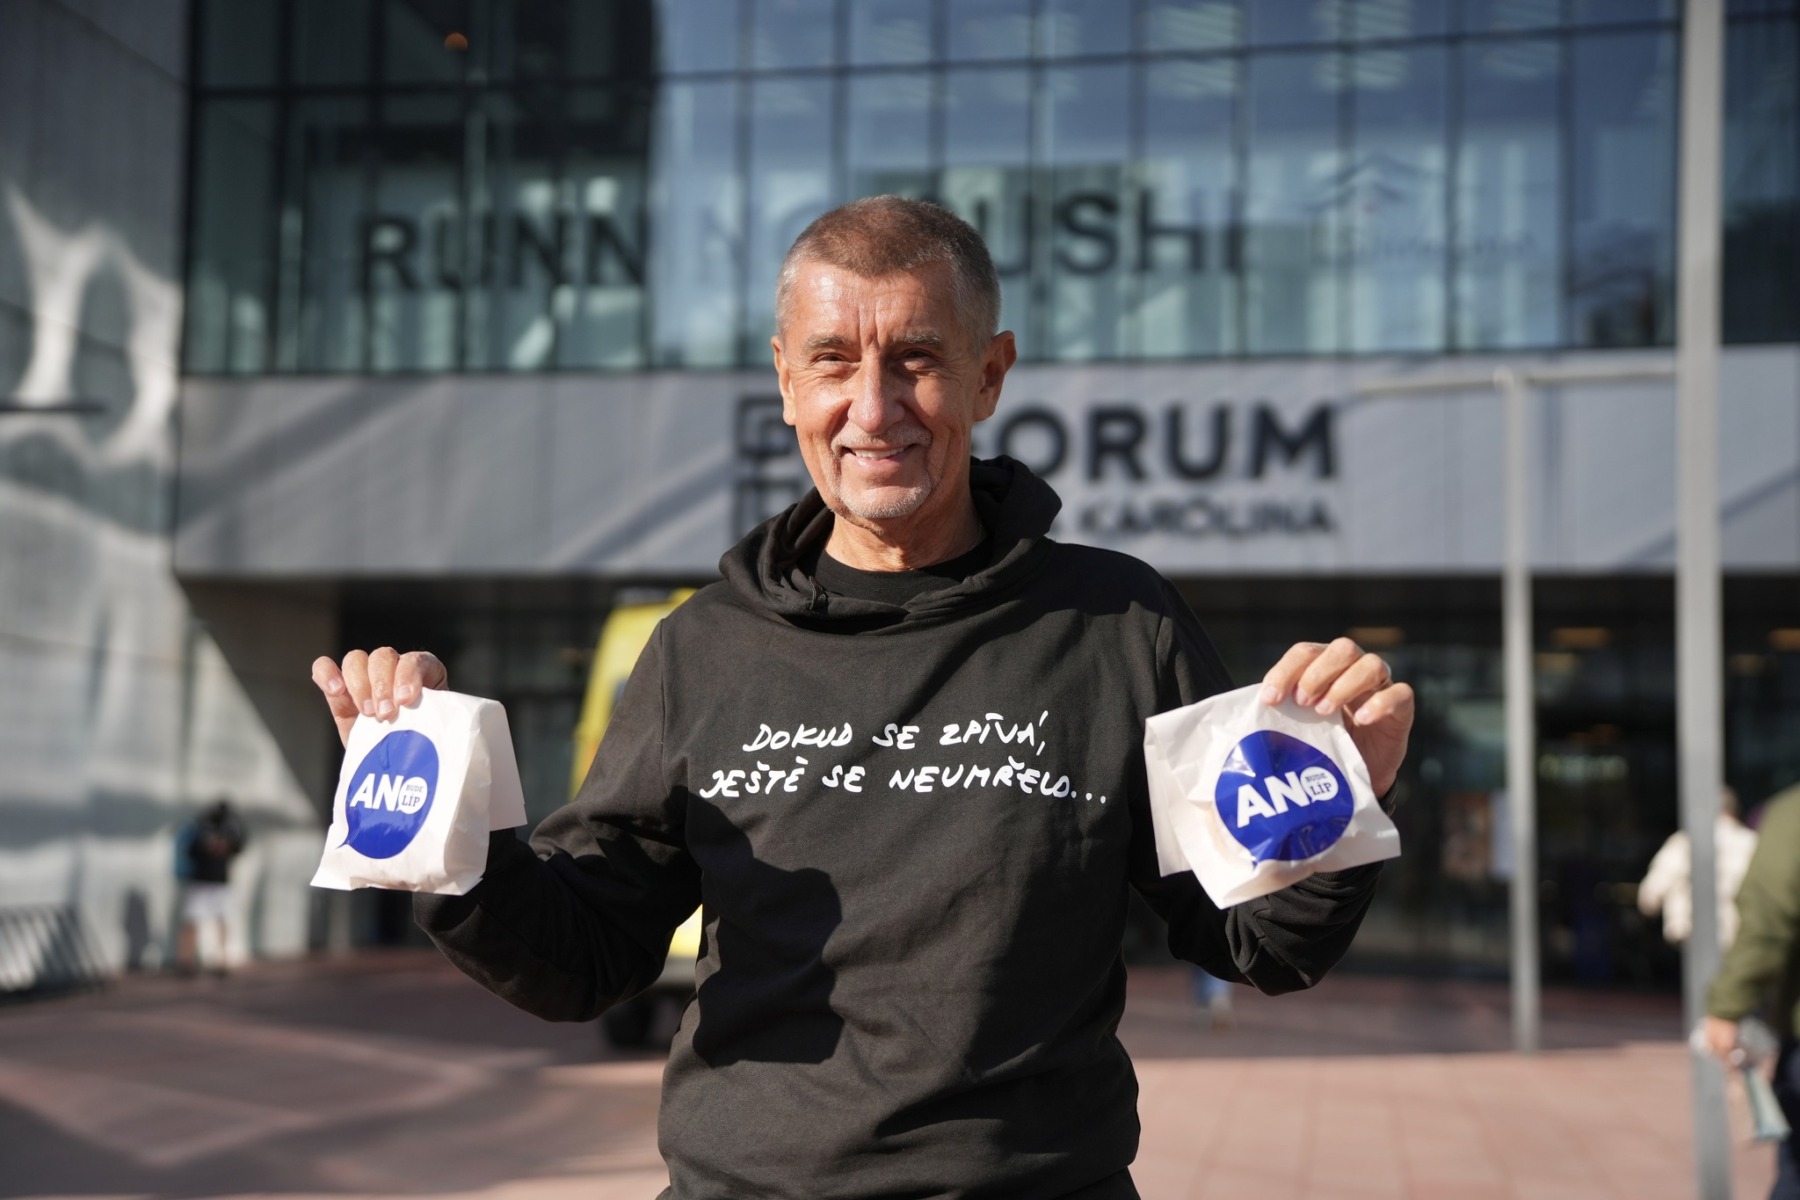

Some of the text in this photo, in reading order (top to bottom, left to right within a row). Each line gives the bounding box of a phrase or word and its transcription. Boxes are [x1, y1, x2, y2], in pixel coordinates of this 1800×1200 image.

[930, 188, 1246, 277] USHI
[971, 403, 1341, 482] ORUM
[742, 723, 854, 752] DOKUD
[872, 723, 920, 750] SE
[822, 765, 866, 793] SE
